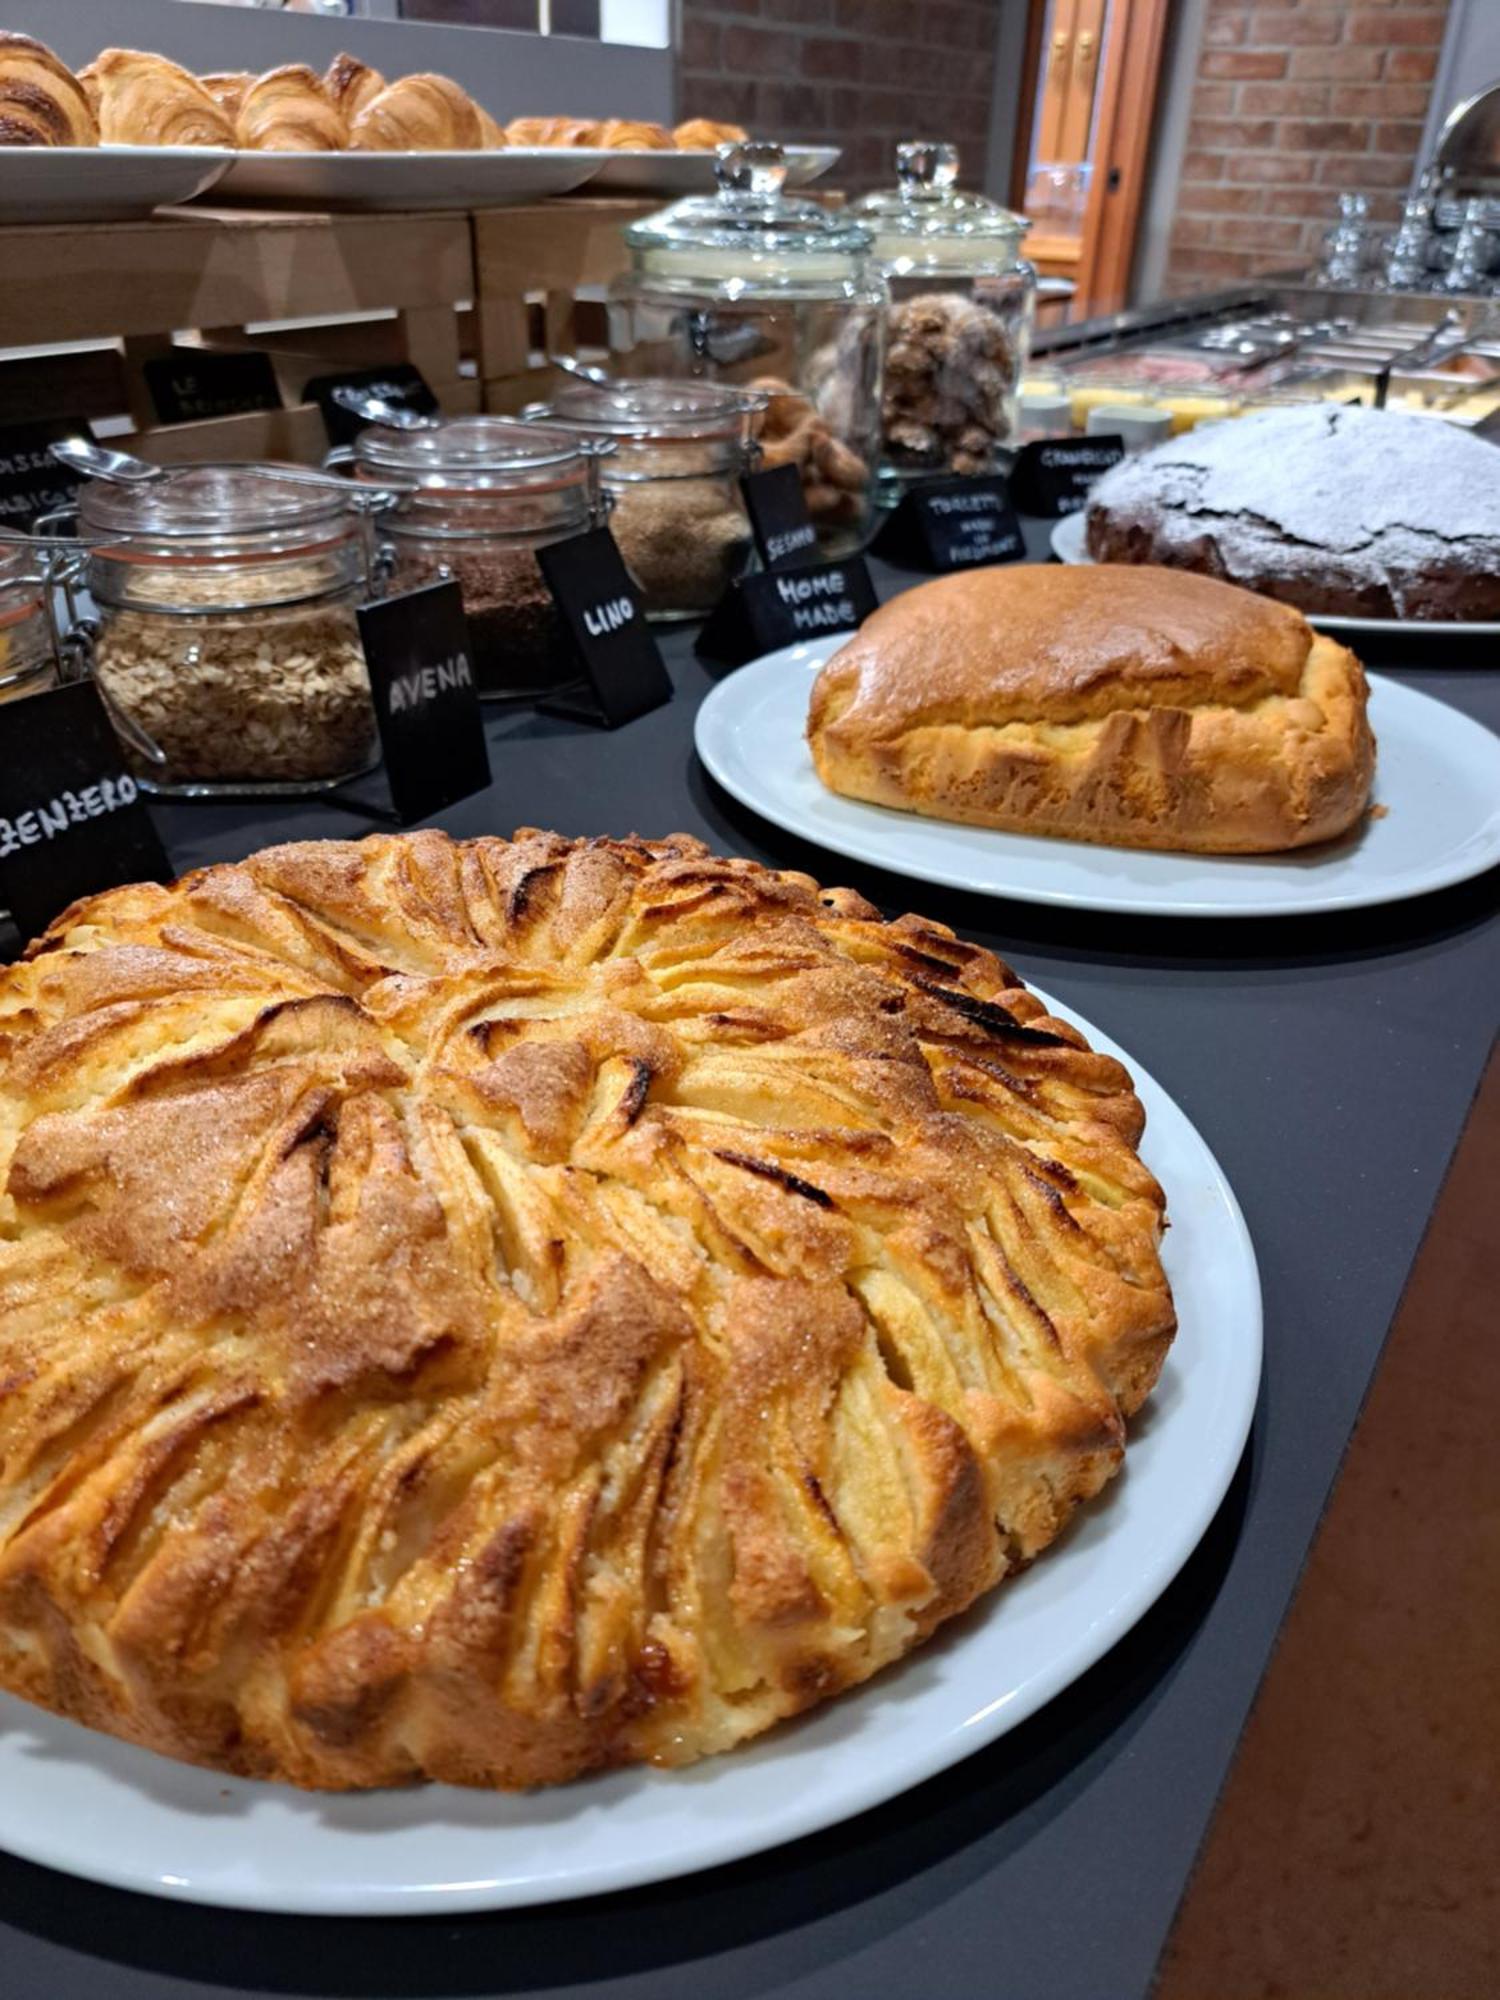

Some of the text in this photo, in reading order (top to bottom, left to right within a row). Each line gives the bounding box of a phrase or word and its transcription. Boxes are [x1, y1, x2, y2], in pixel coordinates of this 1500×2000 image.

[776, 570, 845, 605] HOME
[583, 597, 635, 636] LINO
[793, 598, 857, 630] MADE
[389, 652, 473, 716] AVENA
